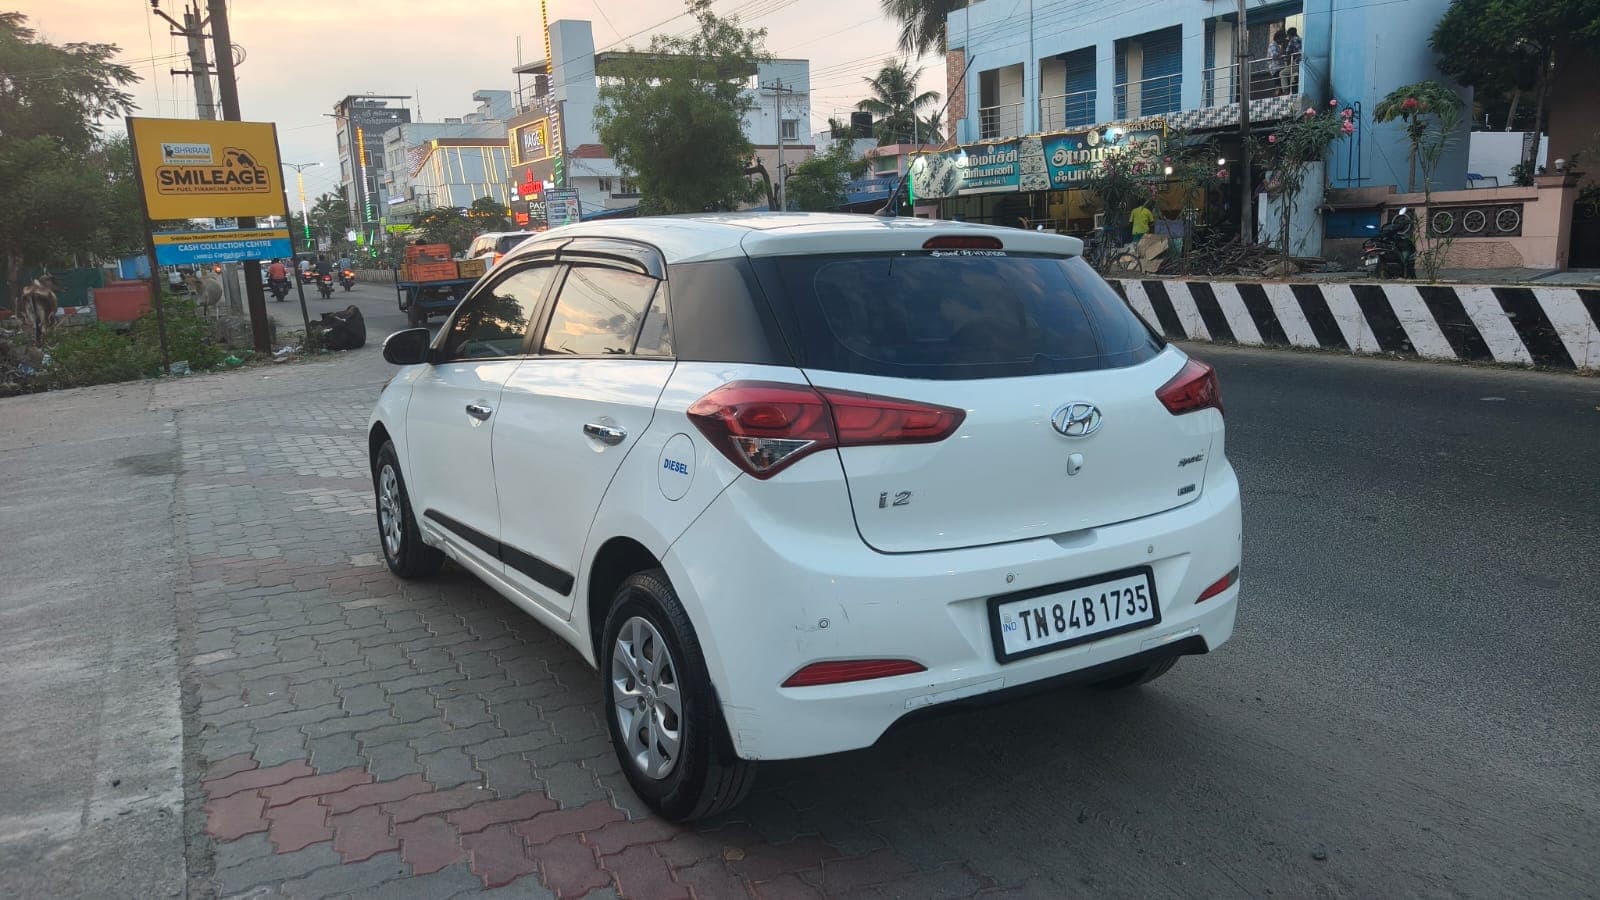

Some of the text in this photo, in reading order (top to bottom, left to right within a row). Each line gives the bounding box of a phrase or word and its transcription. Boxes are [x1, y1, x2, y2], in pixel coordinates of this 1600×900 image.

[160, 169, 267, 185] SMILEAGE
[178, 239, 273, 252] CASH COLLECTION CENTRE
[663, 458, 689, 475] DIESEL
[1002, 584, 1149, 641] IND TN84B1735
